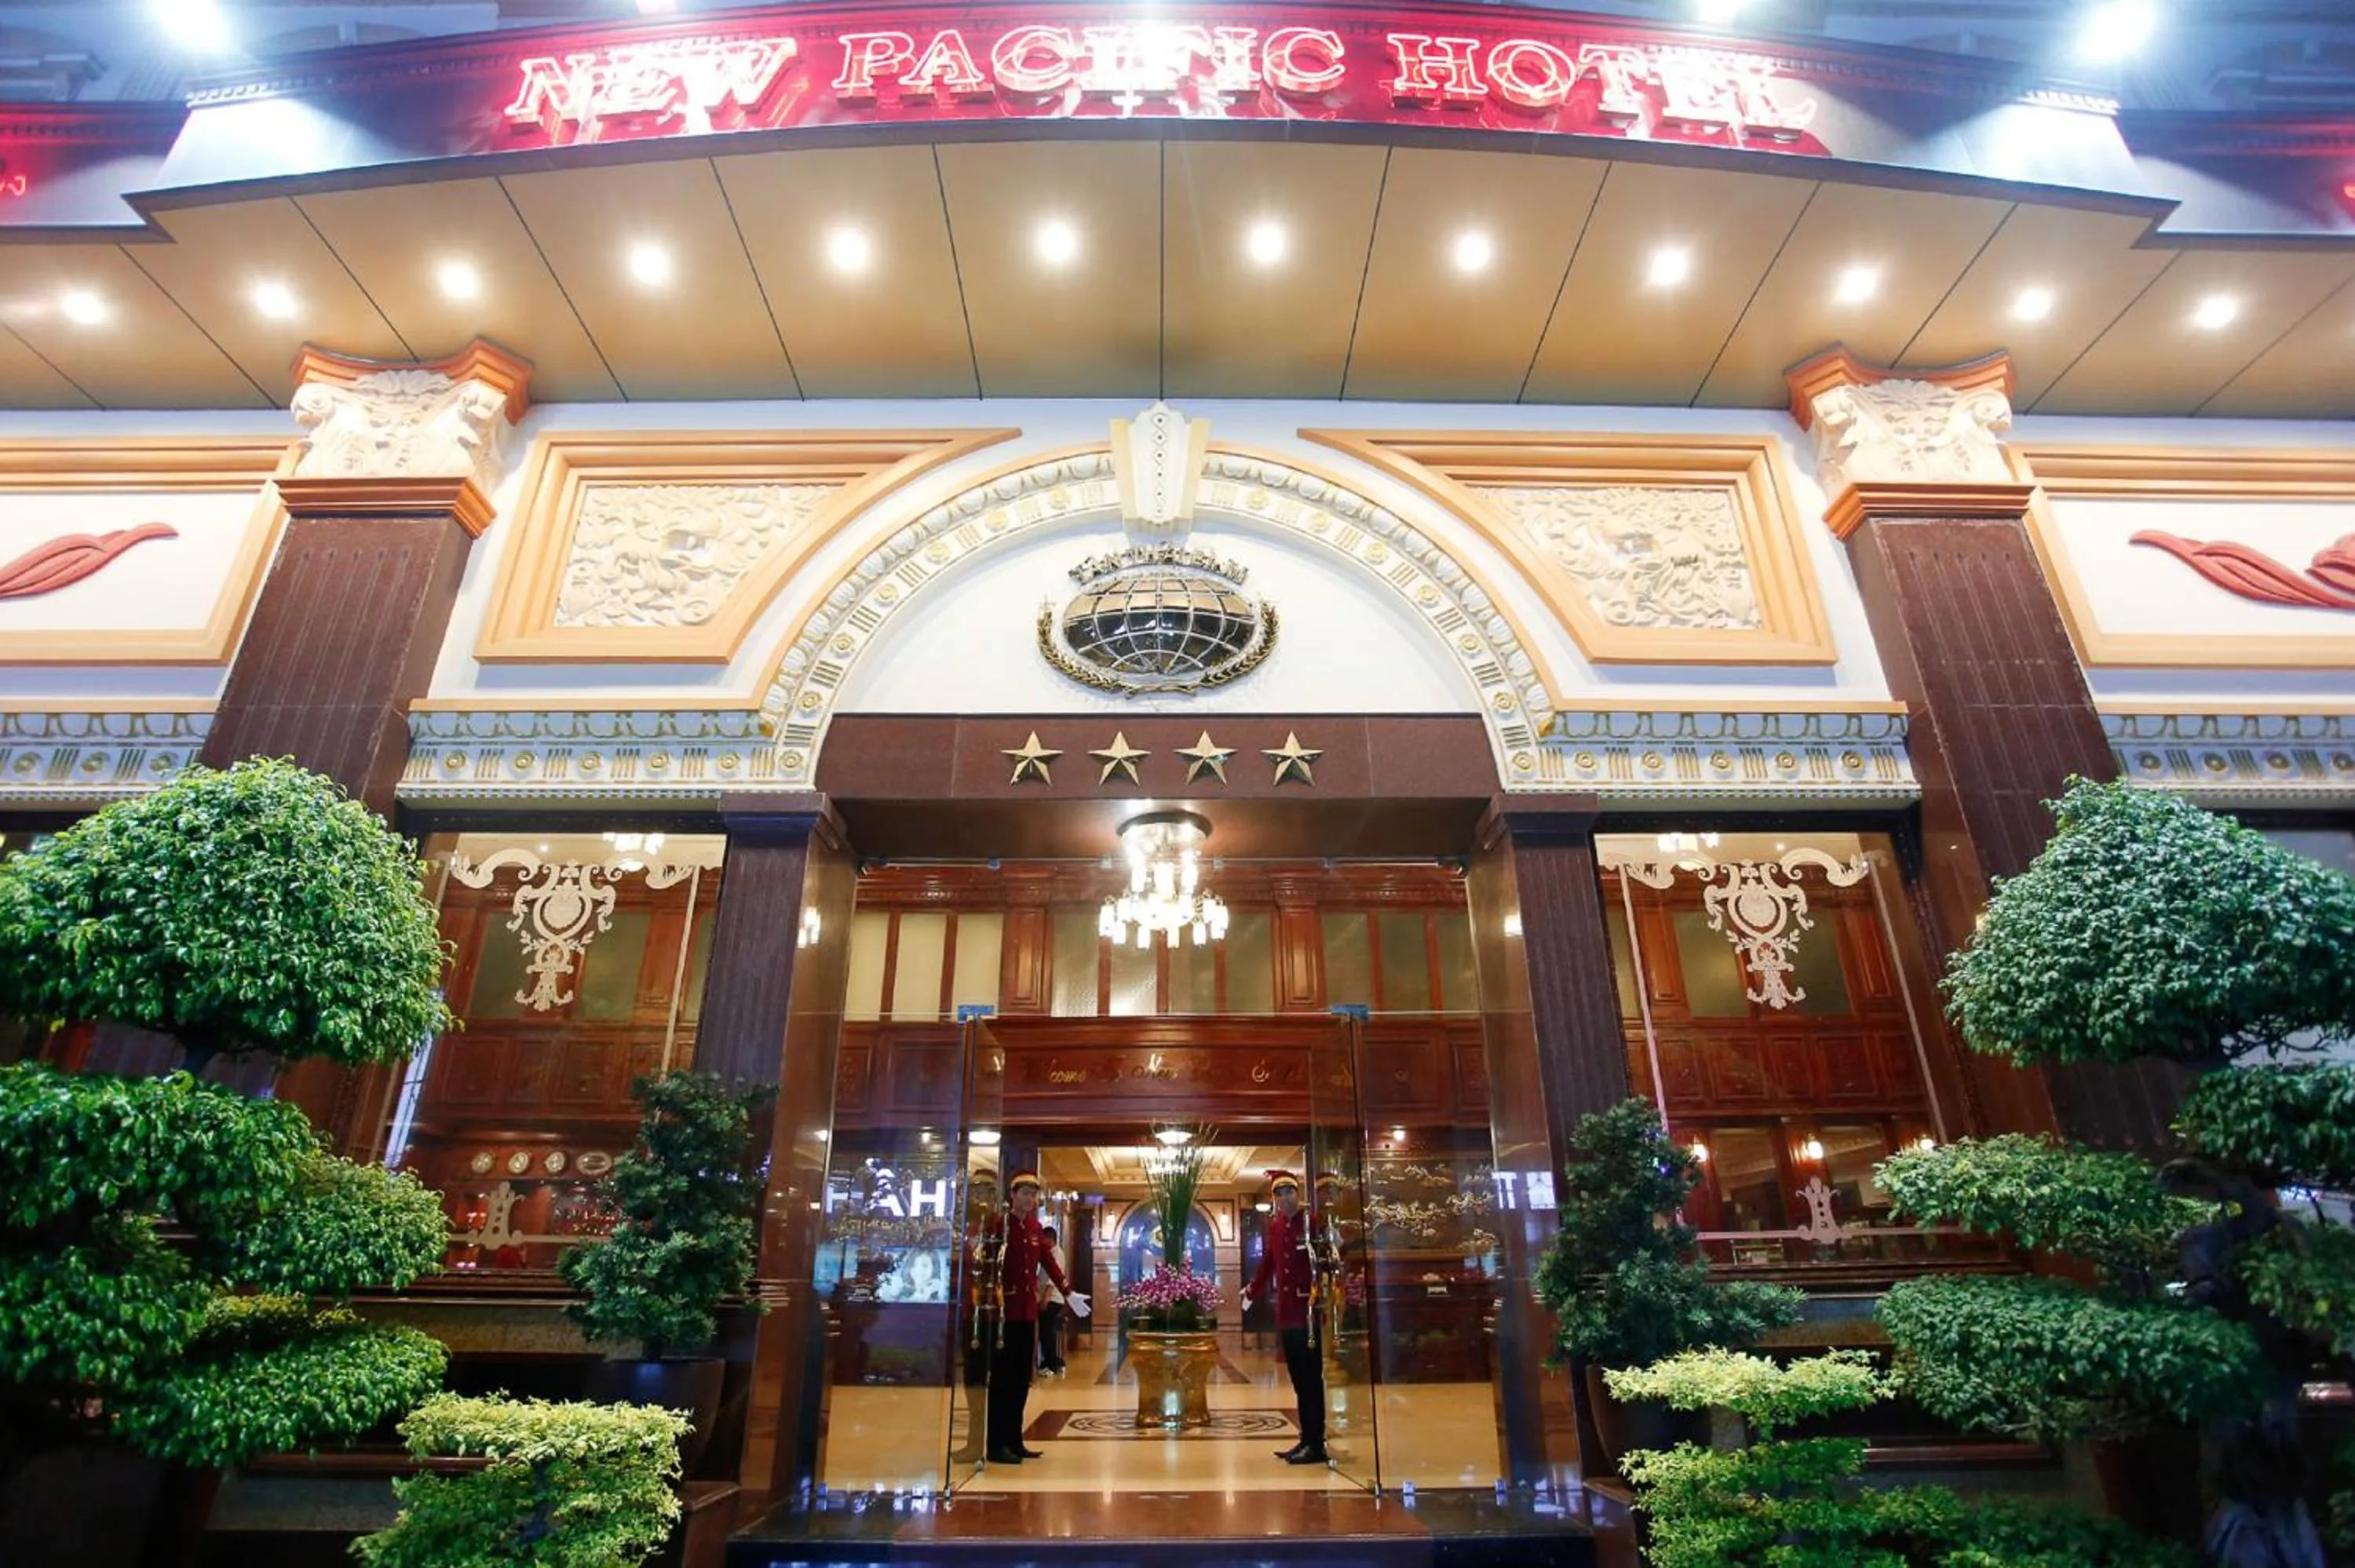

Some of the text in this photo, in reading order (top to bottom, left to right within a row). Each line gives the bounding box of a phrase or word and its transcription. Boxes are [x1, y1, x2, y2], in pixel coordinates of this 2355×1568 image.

[505, 24, 1817, 127] NEW PACIFIC HOTEL
